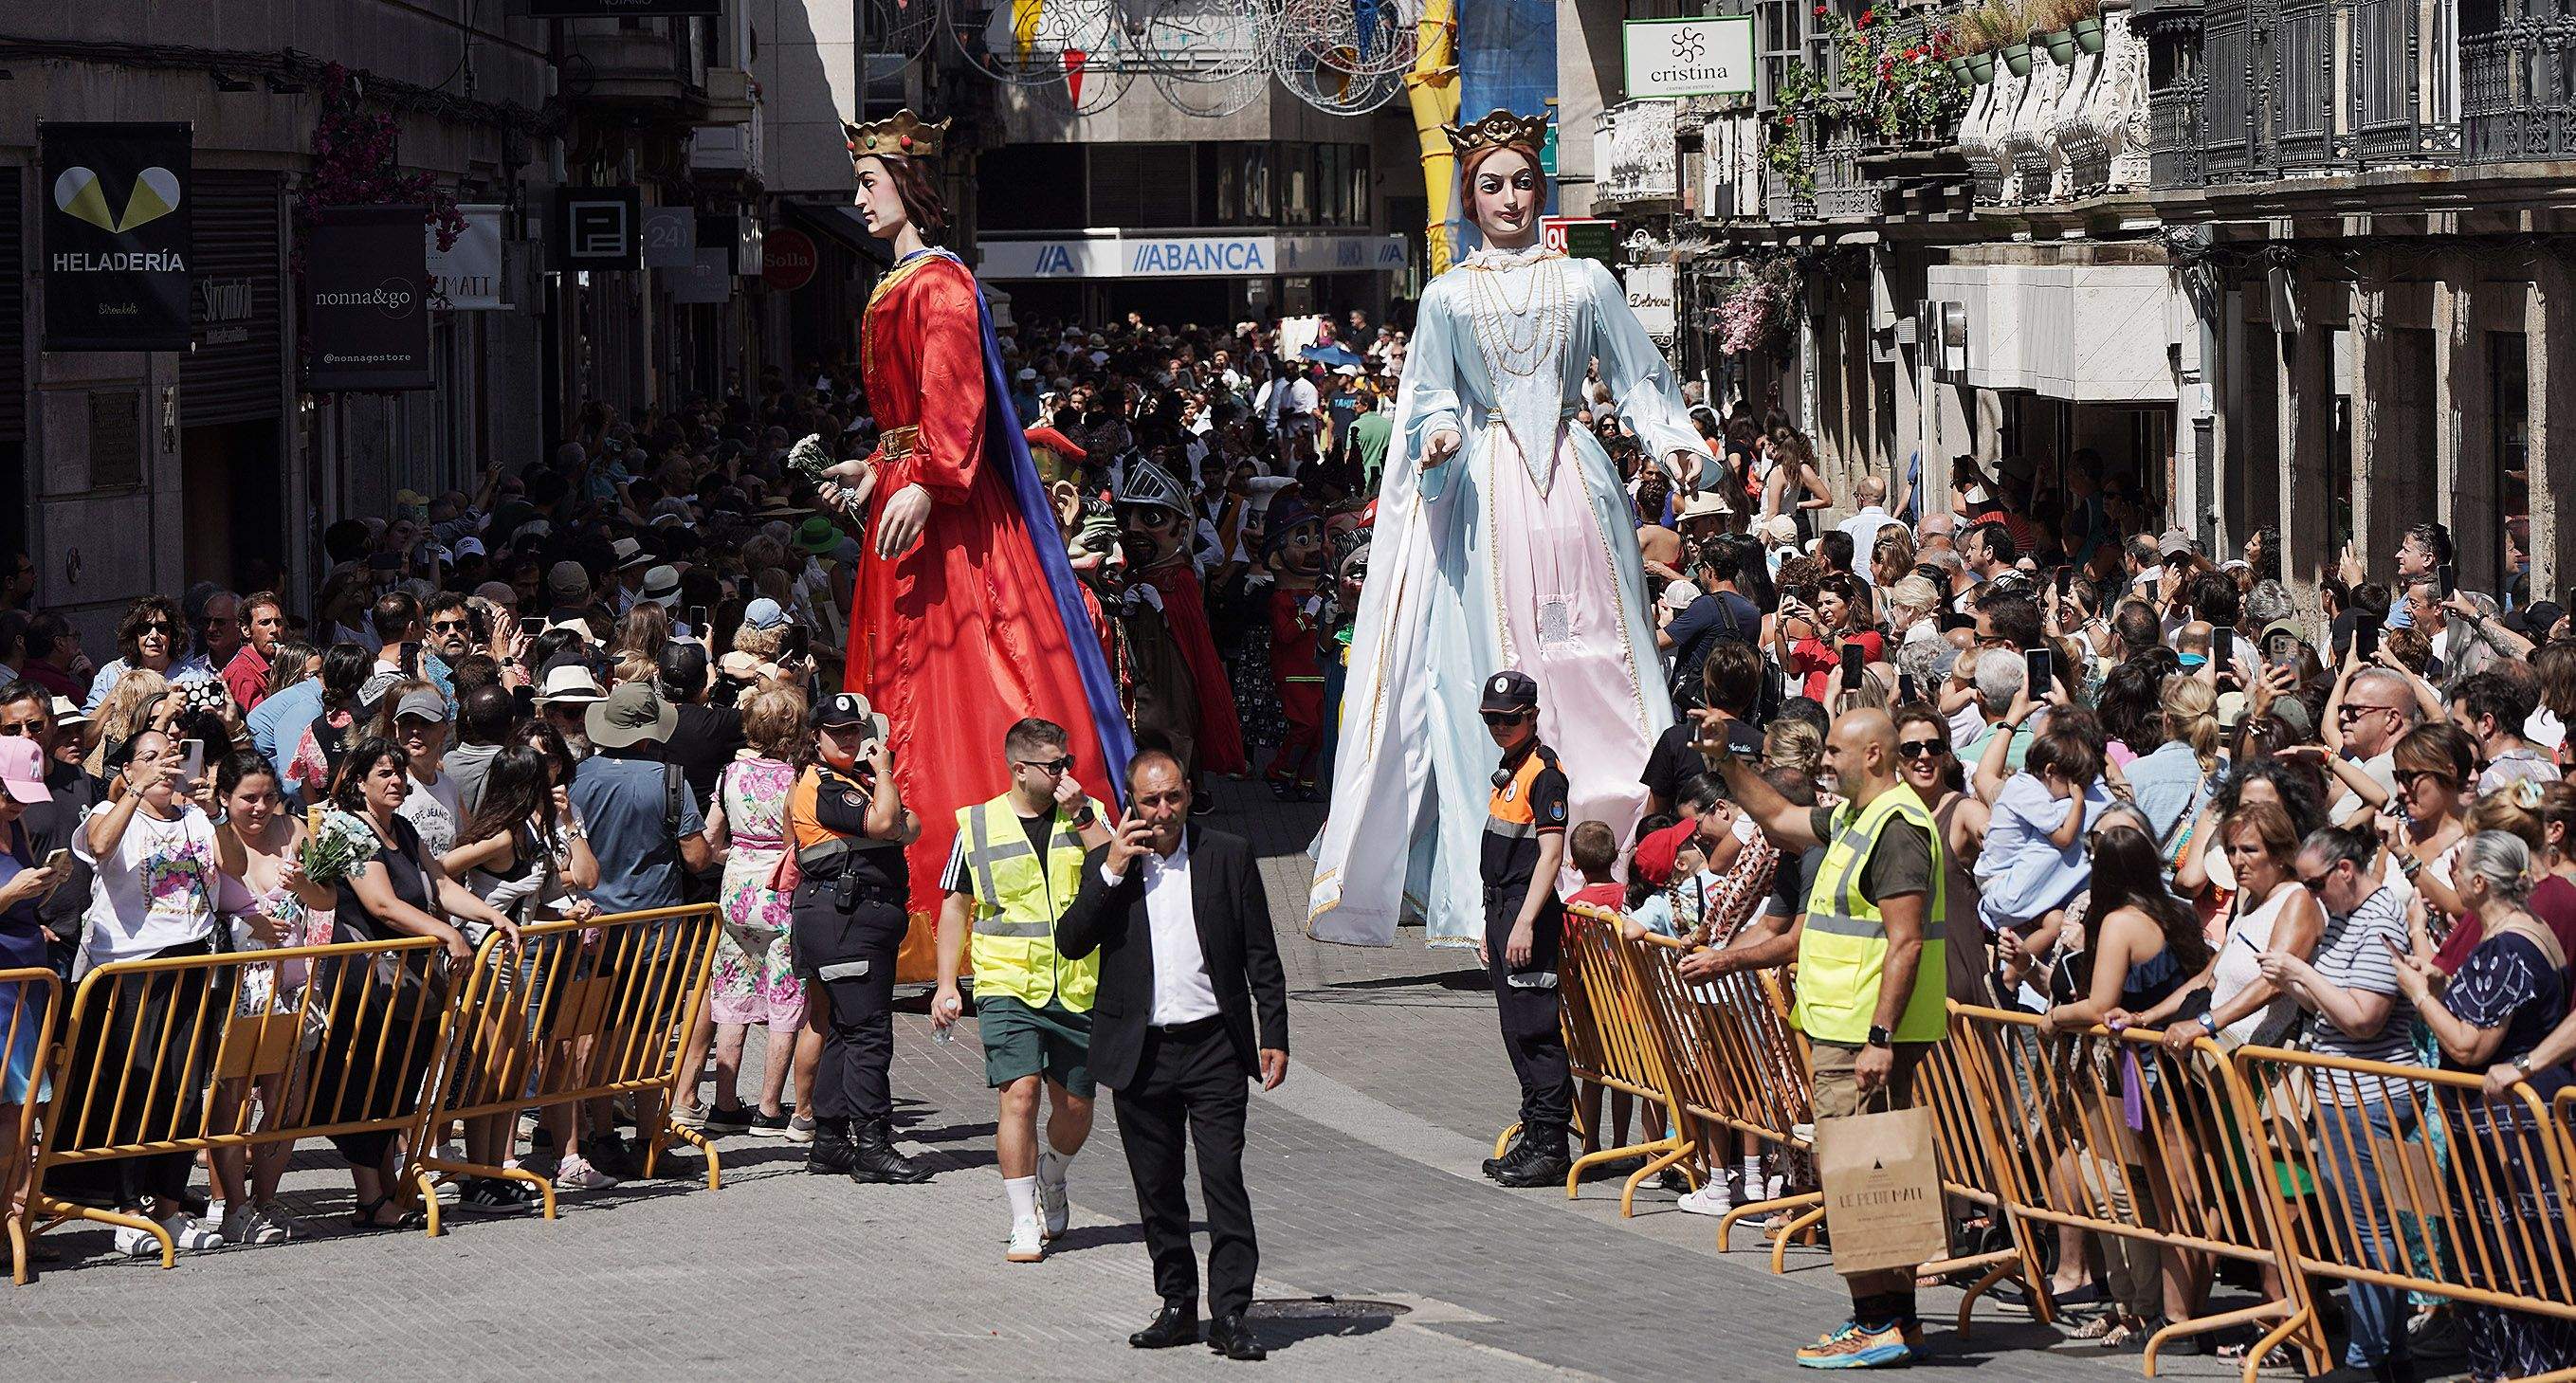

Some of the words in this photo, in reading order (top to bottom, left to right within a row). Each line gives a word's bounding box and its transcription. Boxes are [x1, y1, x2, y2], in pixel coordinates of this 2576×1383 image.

[1651, 64, 1727, 82] cristina
[53, 248, 186, 273] HELADERÍA
[316, 288, 410, 309] nonna&go
[323, 354, 411, 364] @nonnagostore
[411, 810, 426, 826] EPE
[427, 808, 448, 821] JEANS
